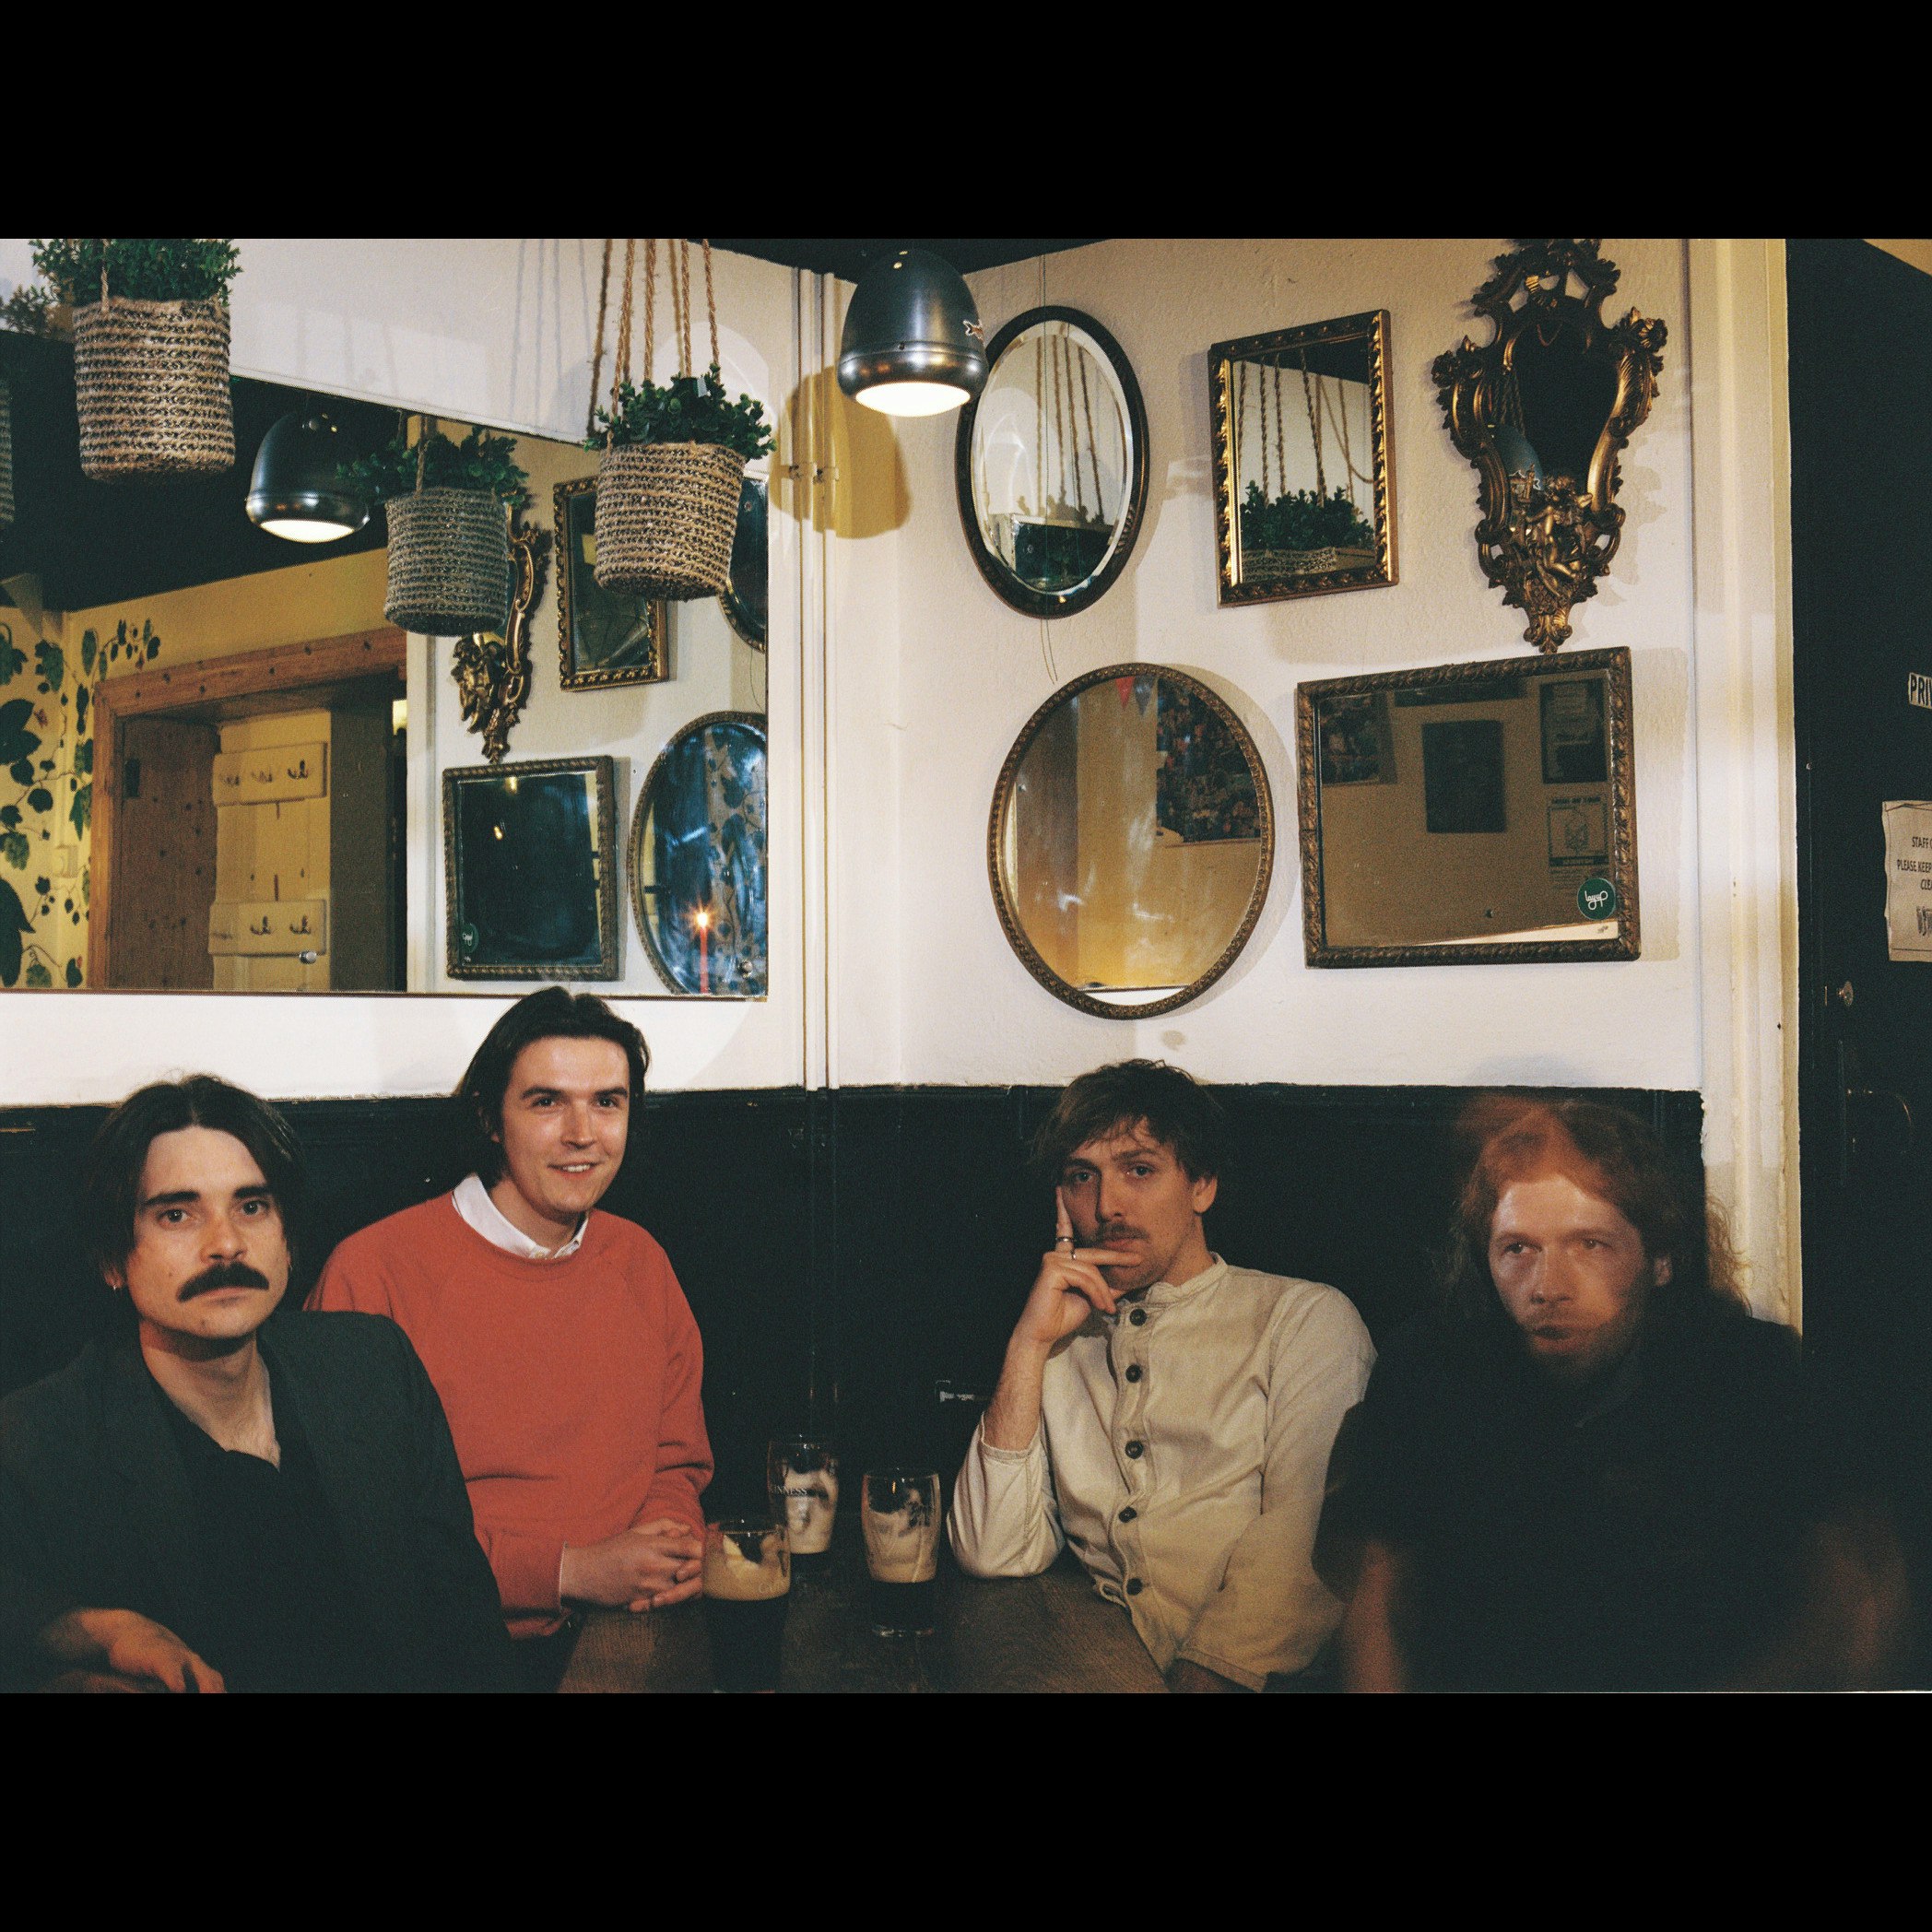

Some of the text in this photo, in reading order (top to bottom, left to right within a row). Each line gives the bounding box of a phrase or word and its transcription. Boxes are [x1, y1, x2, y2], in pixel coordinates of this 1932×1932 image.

[1912, 836, 1928, 848] STAFF
[1896, 859, 1932, 873] PLEASE KEEP
